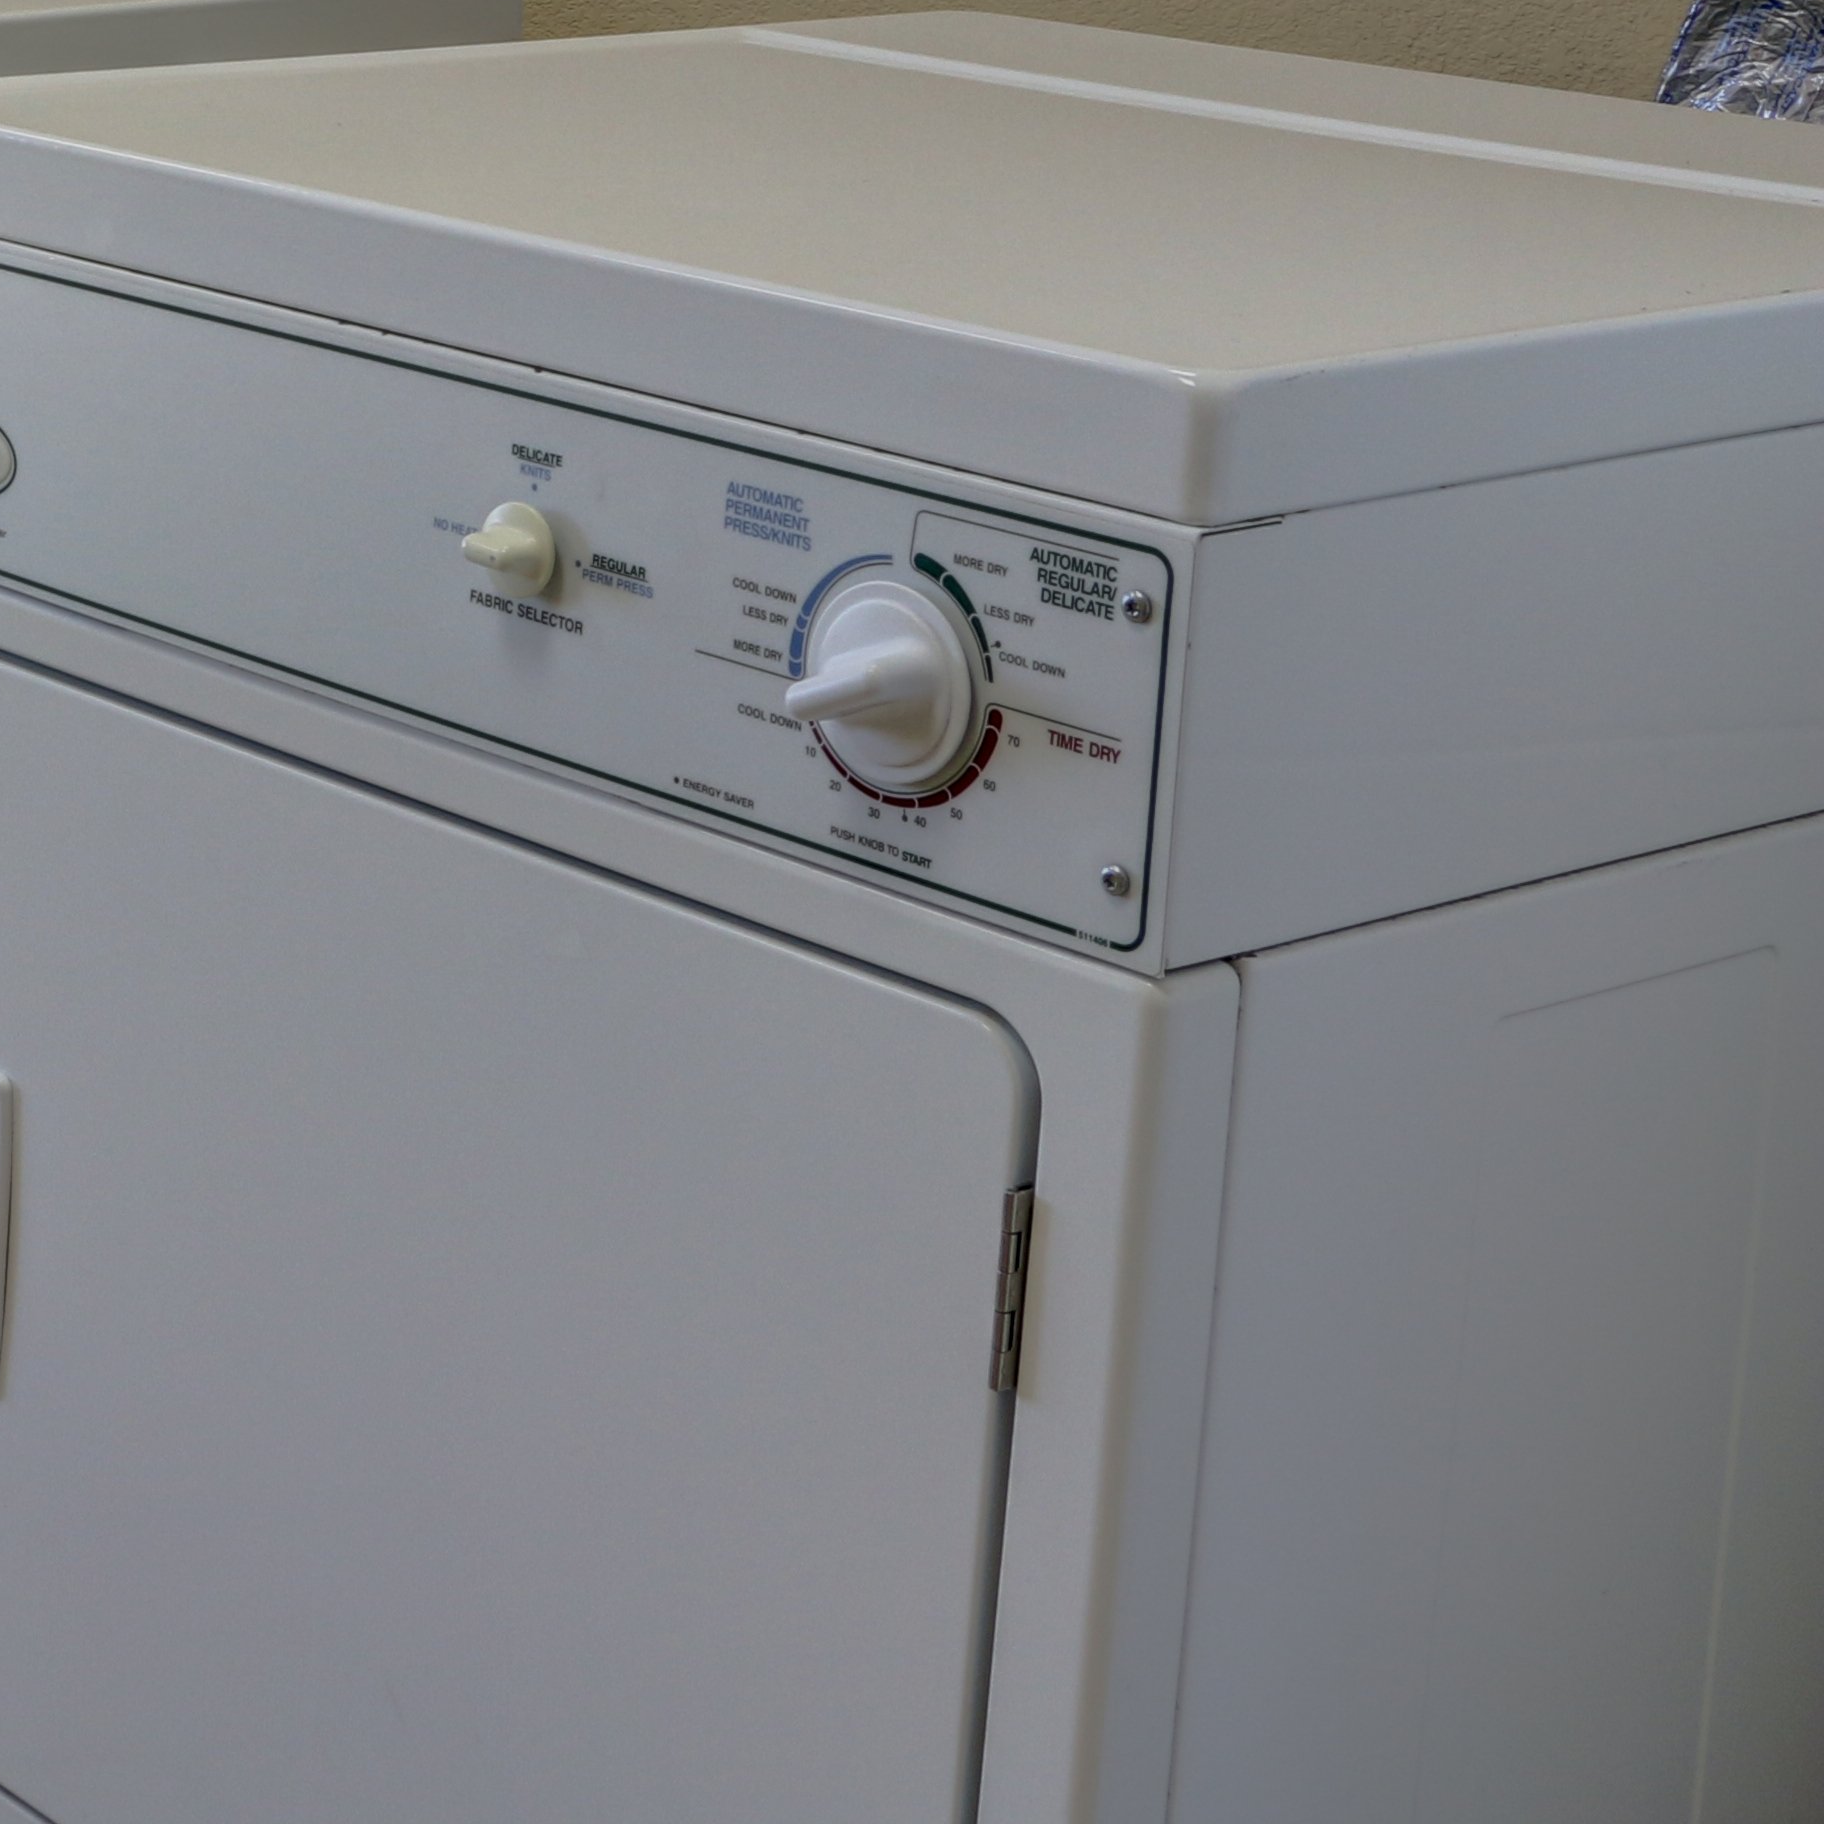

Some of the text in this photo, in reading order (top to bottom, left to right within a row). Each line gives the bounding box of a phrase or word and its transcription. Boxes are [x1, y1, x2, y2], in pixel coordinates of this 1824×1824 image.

[512, 444, 563, 467] DELICATE
[520, 463, 551, 481] KNITS
[727, 481, 804, 513] AUTOMATIC
[433, 517, 449, 531] NO
[726, 498, 810, 532] PERMANENT
[724, 516, 812, 552] PRESS/KNITS
[593, 554, 646, 579] REGULAR
[954, 553, 1008, 577] MORE DRY
[1029, 547, 1118, 582] AUTOMATIC
[582, 568, 654, 599] PERM PRESS
[732, 576, 797, 604] COOL DOWN
[1037, 568, 1117, 601] REGULAR/
[470, 589, 583, 635] FABRIC SELECTOR
[742, 604, 789, 627] LESS DRY
[984, 603, 1035, 627] LESS DRY
[1040, 588, 1115, 621] DELICATE
[733, 639, 783, 662] MORE DRY
[999, 651, 1066, 678] COOL DOWN
[738, 703, 802, 732] COOL DOWN
[805, 745, 816, 758] 10
[1007, 734, 1020, 748] 70
[1048, 729, 1121, 764] TIME DRY
[682, 778, 755, 810] ENERGY SAVER
[829, 779, 842, 791] 20
[983, 779, 996, 792] 60
[867, 807, 880, 819] 30
[914, 815, 927, 828] 40
[950, 807, 963, 820] 50
[830, 826, 932, 869] PUSH KNOB TO START
